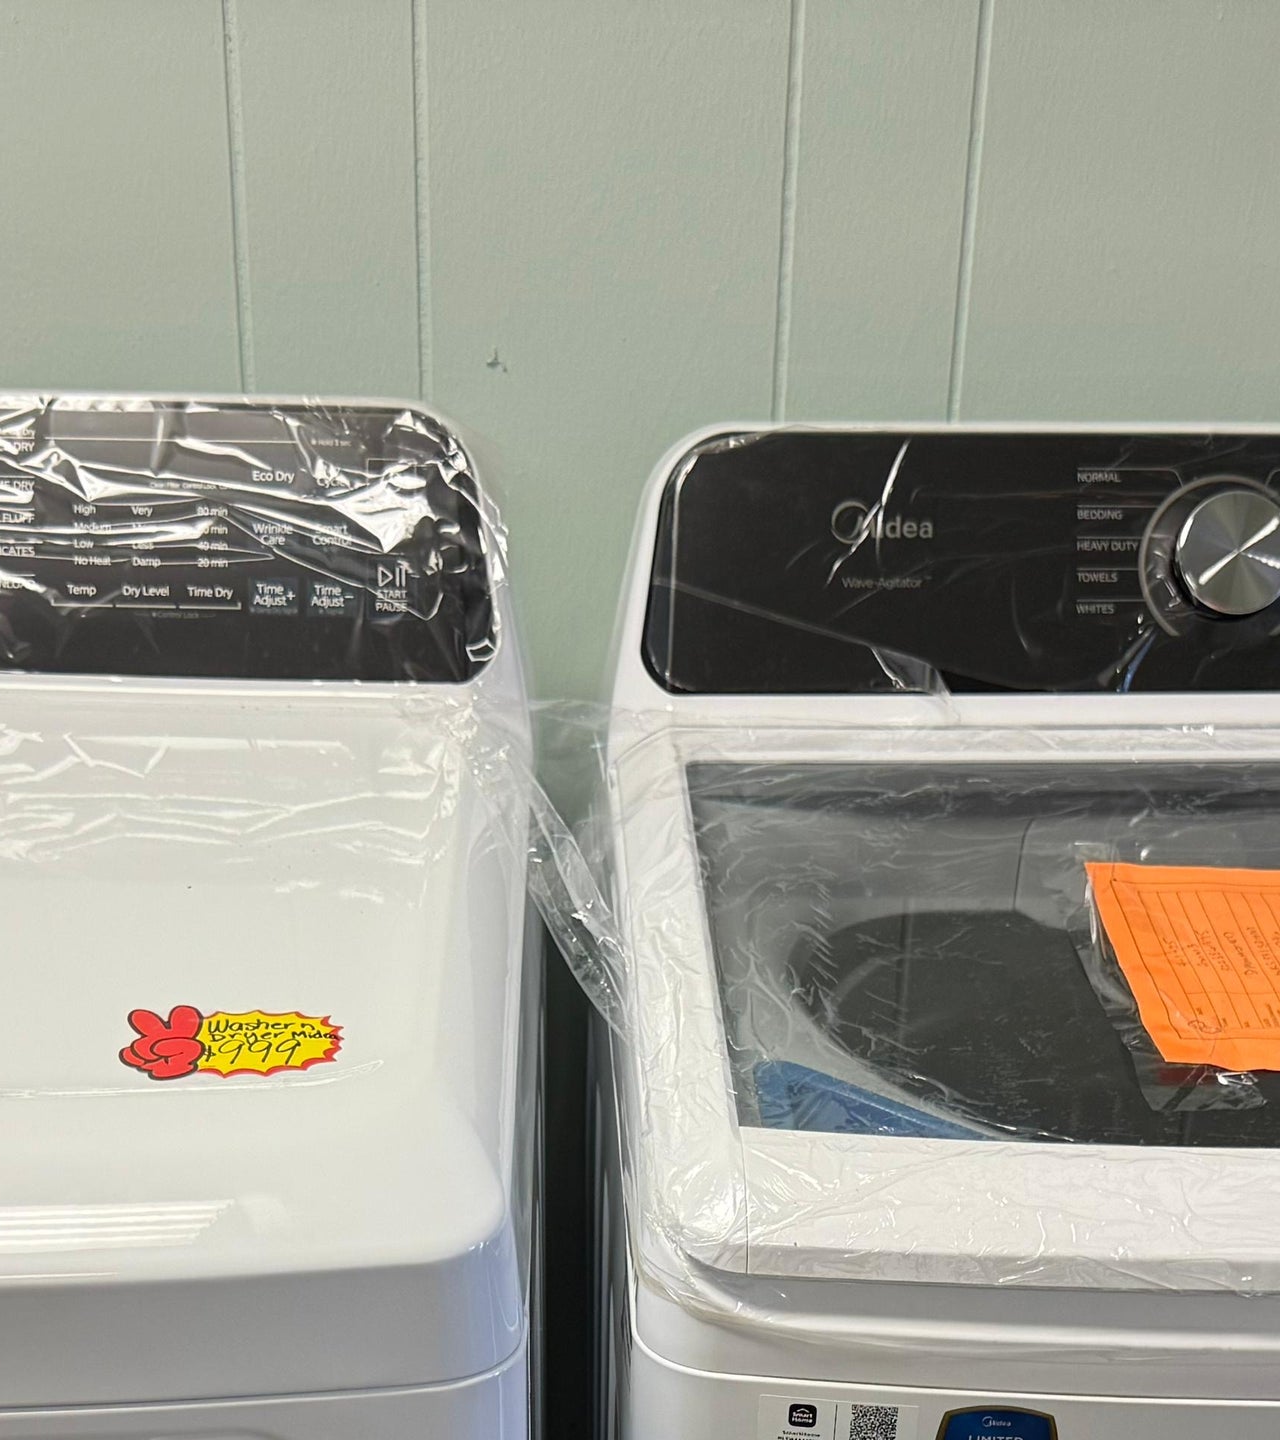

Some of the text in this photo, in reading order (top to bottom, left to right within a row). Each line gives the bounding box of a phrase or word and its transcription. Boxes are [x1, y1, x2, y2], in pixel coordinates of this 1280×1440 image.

[252, 471, 295, 484] Eco Dry
[1076, 472, 1121, 483] NORMAL
[73, 504, 97, 516] High
[131, 505, 154, 518] Very
[1076, 509, 1123, 520] BEDDING
[73, 540, 94, 550] Low
[1076, 540, 1139, 551] HEAVY DUTY
[132, 556, 162, 569] Damp
[1076, 572, 1119, 583] TOWELS
[66, 584, 97, 597] Temp
[122, 585, 170, 598] Dry Level
[186, 586, 234, 600] Time Dry
[256, 583, 284, 595] Time
[313, 584, 342, 596] Time
[253, 594, 287, 608] Adjust
[310, 595, 345, 609] Adjust
[375, 602, 408, 612] PAUSE
[1075, 603, 1115, 615] WHITES
[208, 1019, 296, 1033] Washer
[209, 1030, 285, 1045] Dryer
[204, 1038, 301, 1065] $999
[982, 1416, 1011, 1427] Midea
